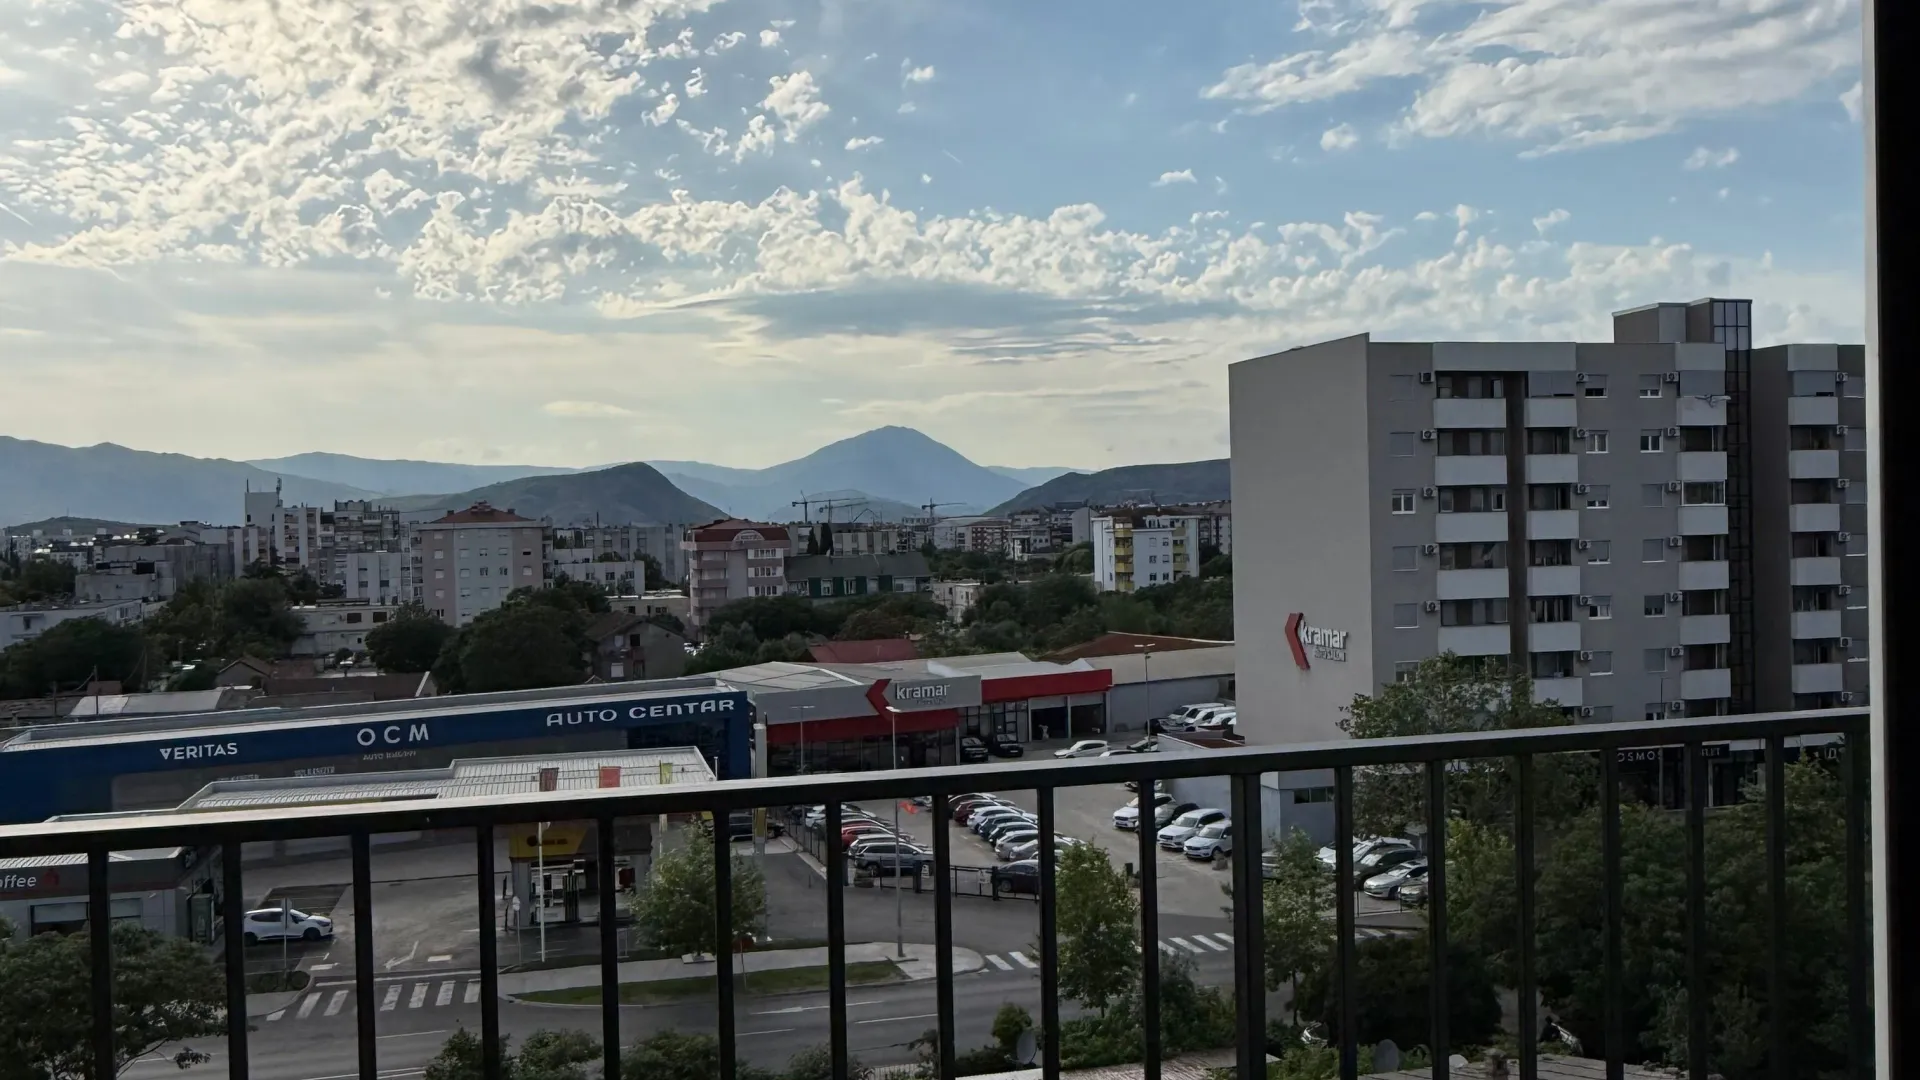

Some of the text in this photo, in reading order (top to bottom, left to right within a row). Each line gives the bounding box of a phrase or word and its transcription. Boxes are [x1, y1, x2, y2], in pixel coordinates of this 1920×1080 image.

[1300, 619, 1346, 648] kramar
[896, 683, 950, 699] kramar
[546, 699, 735, 726] AUTO CENTAR
[357, 723, 429, 746] OCM
[159, 742, 238, 760] VERITAS
